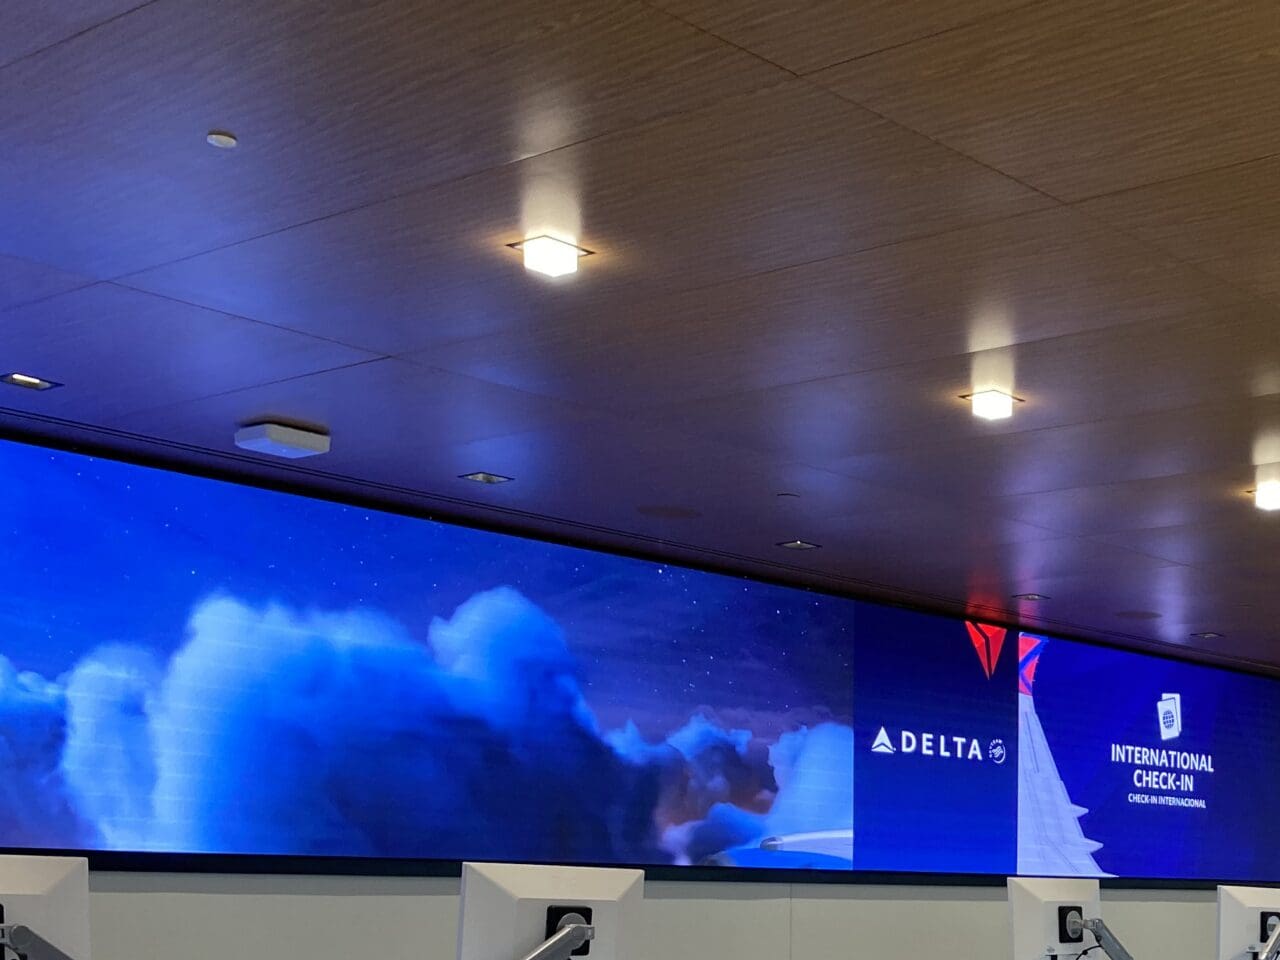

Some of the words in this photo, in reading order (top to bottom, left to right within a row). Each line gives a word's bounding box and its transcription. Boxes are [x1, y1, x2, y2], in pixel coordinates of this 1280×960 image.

[901, 730, 983, 761] DELTA
[1111, 743, 1215, 773] INTERNATIONAL
[1133, 769, 1194, 792] CHECK-IN
[1127, 793, 1158, 805] CHECK-IN
[1158, 795, 1207, 809] INTERNACIONAL
